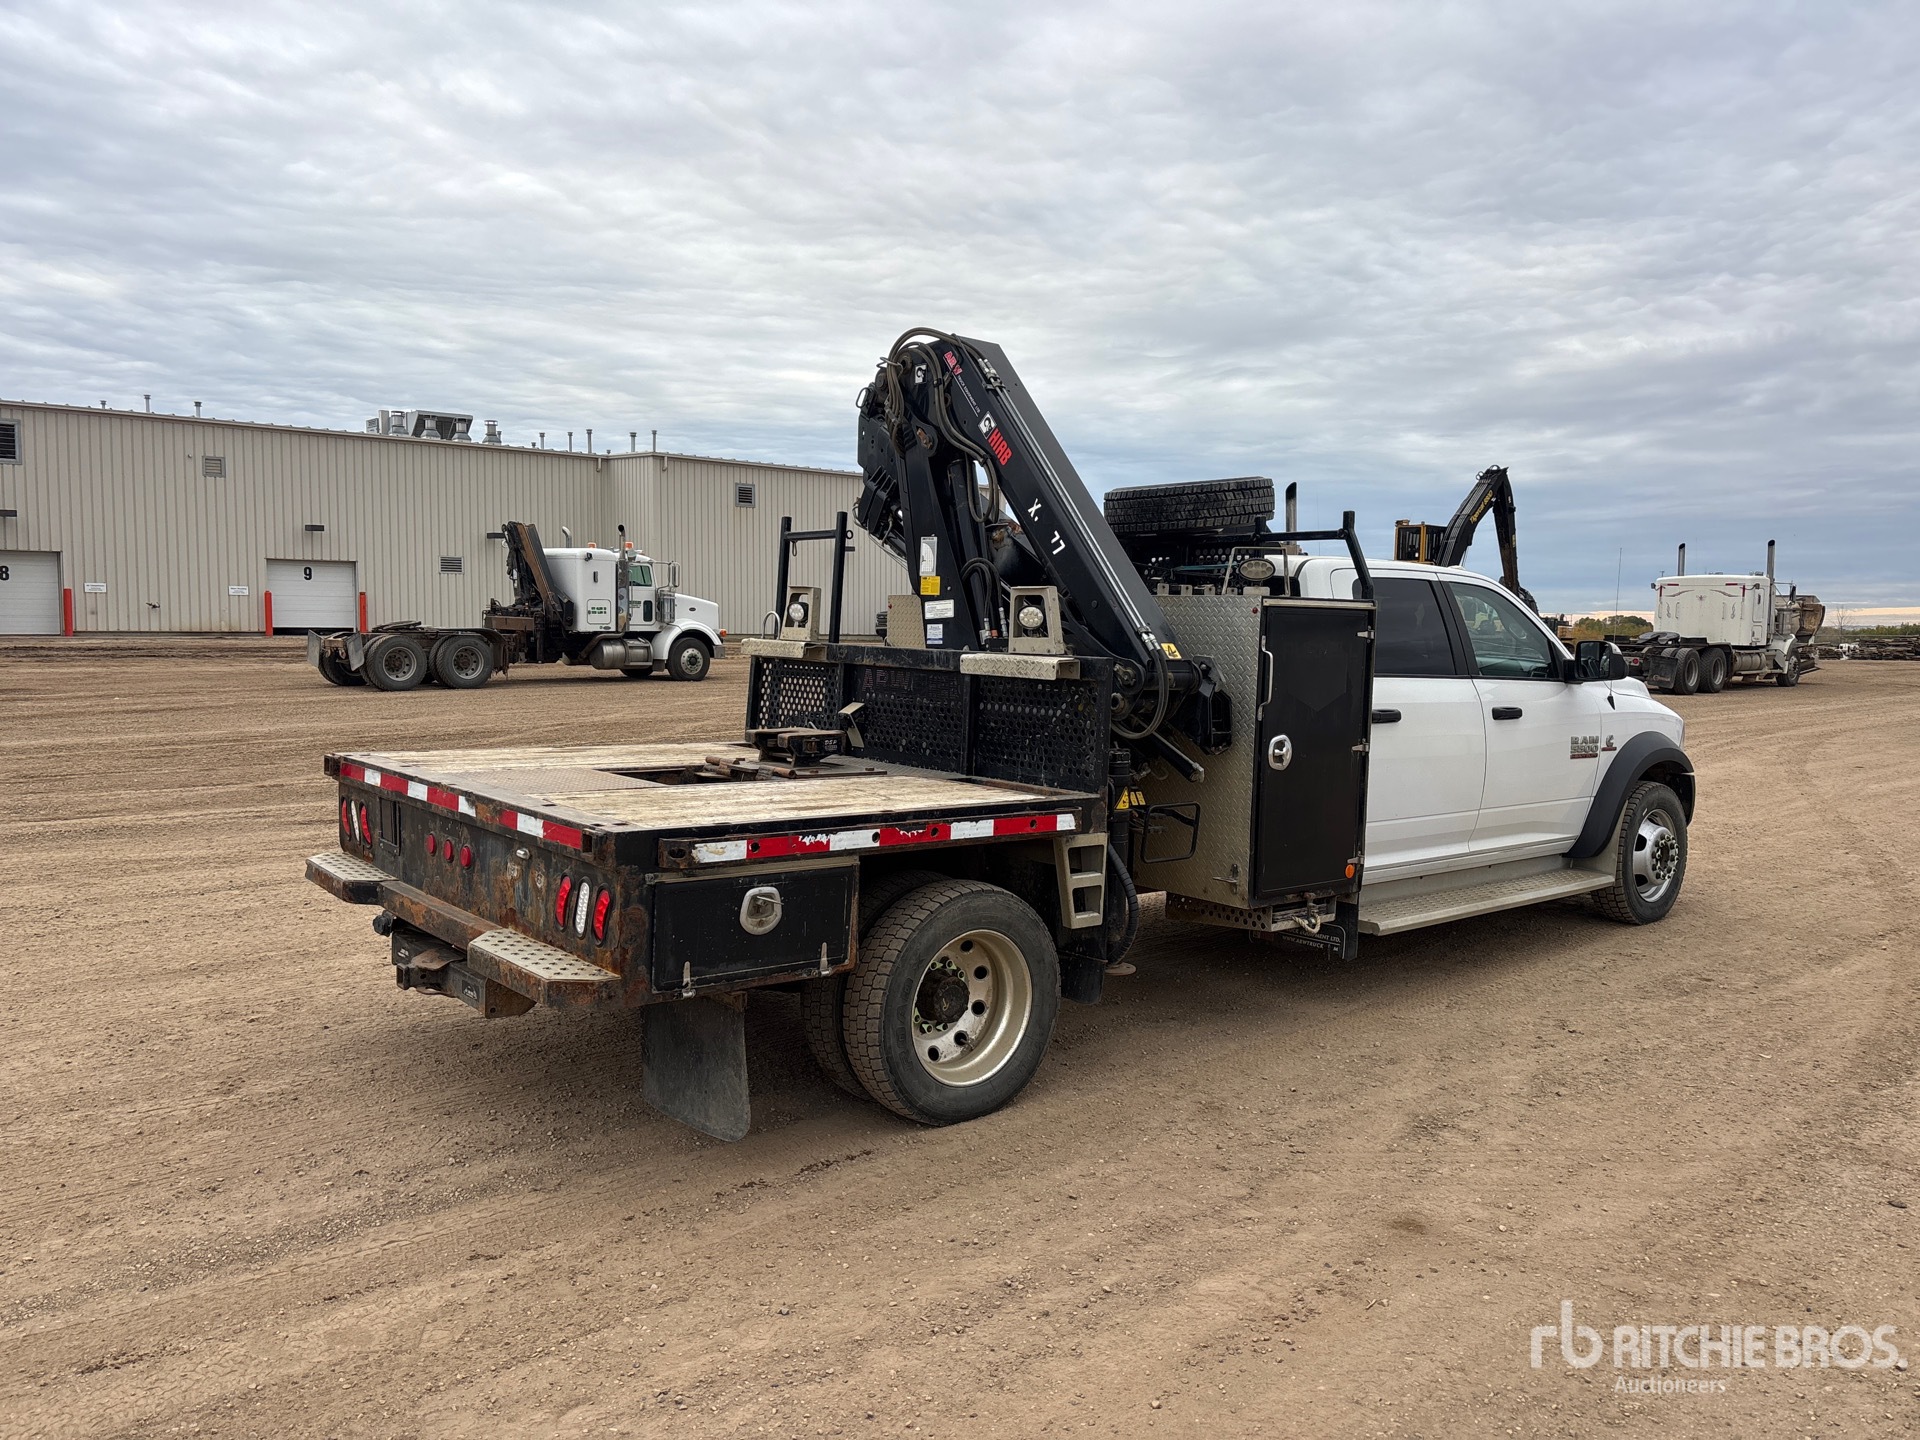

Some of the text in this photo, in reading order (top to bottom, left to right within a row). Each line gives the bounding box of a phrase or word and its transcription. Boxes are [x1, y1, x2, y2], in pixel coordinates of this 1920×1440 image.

[987, 427, 1013, 466] HIAB
[0, 565, 10, 581] 8
[303, 566, 313, 581] 9
[1570, 736, 1599, 744] RAM
[1570, 744, 1599, 754] 5500
